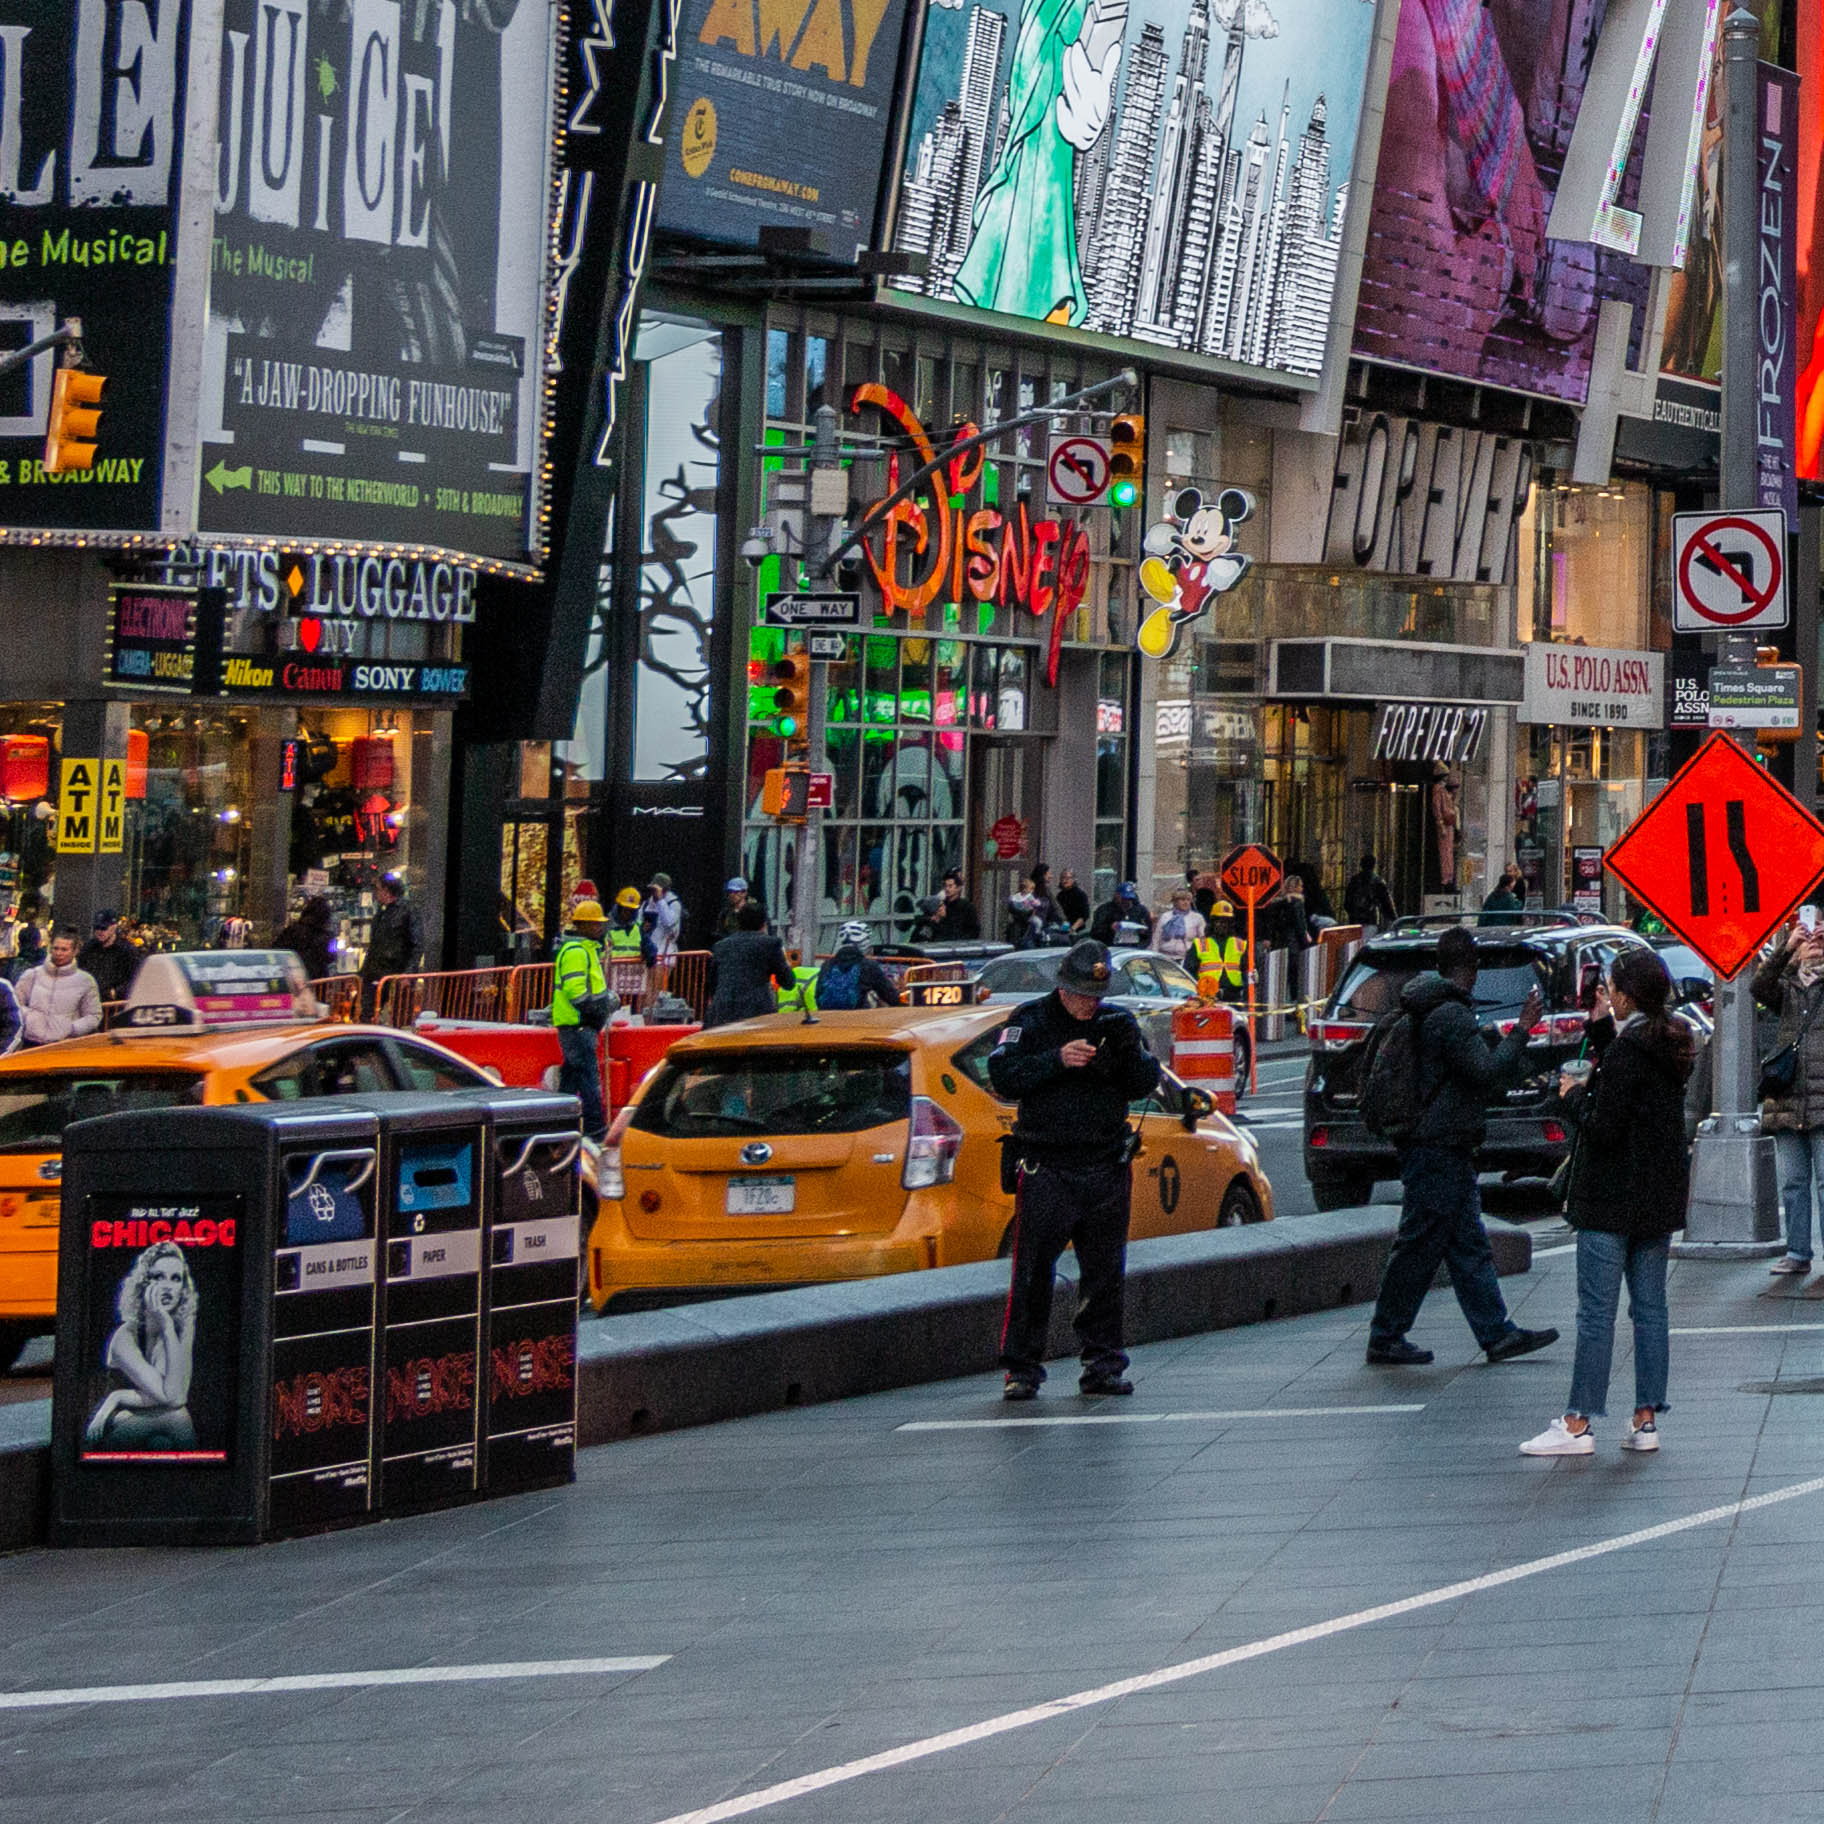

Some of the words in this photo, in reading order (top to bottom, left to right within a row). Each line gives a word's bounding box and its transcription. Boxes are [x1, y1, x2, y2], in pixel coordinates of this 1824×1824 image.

[212, 237, 241, 275] The
[1757, 140, 1785, 449] FROZEN
[257, 370, 401, 422] JAW-DROPPING
[258, 469, 281, 494] THIS
[283, 472, 306, 497] WAY
[309, 475, 325, 499] TO
[327, 477, 344, 501] THE
[346, 478, 420, 508] NETHERWORLD
[472, 490, 524, 518] BROADWAY
[1322, 406, 1536, 585] FOREVER
[309, 554, 479, 623] LUGGAGE
[780, 602, 808, 616] ONE
[819, 601, 849, 616] WAY
[318, 618, 359, 653] NY
[224, 658, 274, 687] Nikon
[281, 663, 343, 692] Canon
[353, 665, 415, 691] SONY
[420, 667, 468, 694] BOWER
[1545, 652, 1572, 690] U.S.
[1574, 656, 1611, 693] POLO
[1611, 659, 1652, 696] ASSN.
[1675, 678, 1700, 690] U.S.
[1675, 690, 1710, 702] POLO
[1713, 682, 1745, 693] Times
[1746, 683, 1785, 694] Square
[1713, 695, 1767, 705] Pedestrian
[1767, 695, 1795, 705] Plaza
[1570, 700, 1600, 718] SINCE
[1602, 701, 1628, 720] 1890
[1373, 704, 1460, 760] FOREVER
[1460, 708, 1489, 763] 21
[64, 763, 92, 839] ATM
[104, 763, 121, 839] ATM
[1228, 865, 1273, 887] SLOW
[922, 985, 963, 1005] 1F20
[91, 1218, 237, 1249] CHICAGO
[523, 1233, 547, 1250] TRASH
[306, 1259, 326, 1277] CANS
[336, 1254, 369, 1273] BOTTLES
[422, 1246, 446, 1264] PAPER
